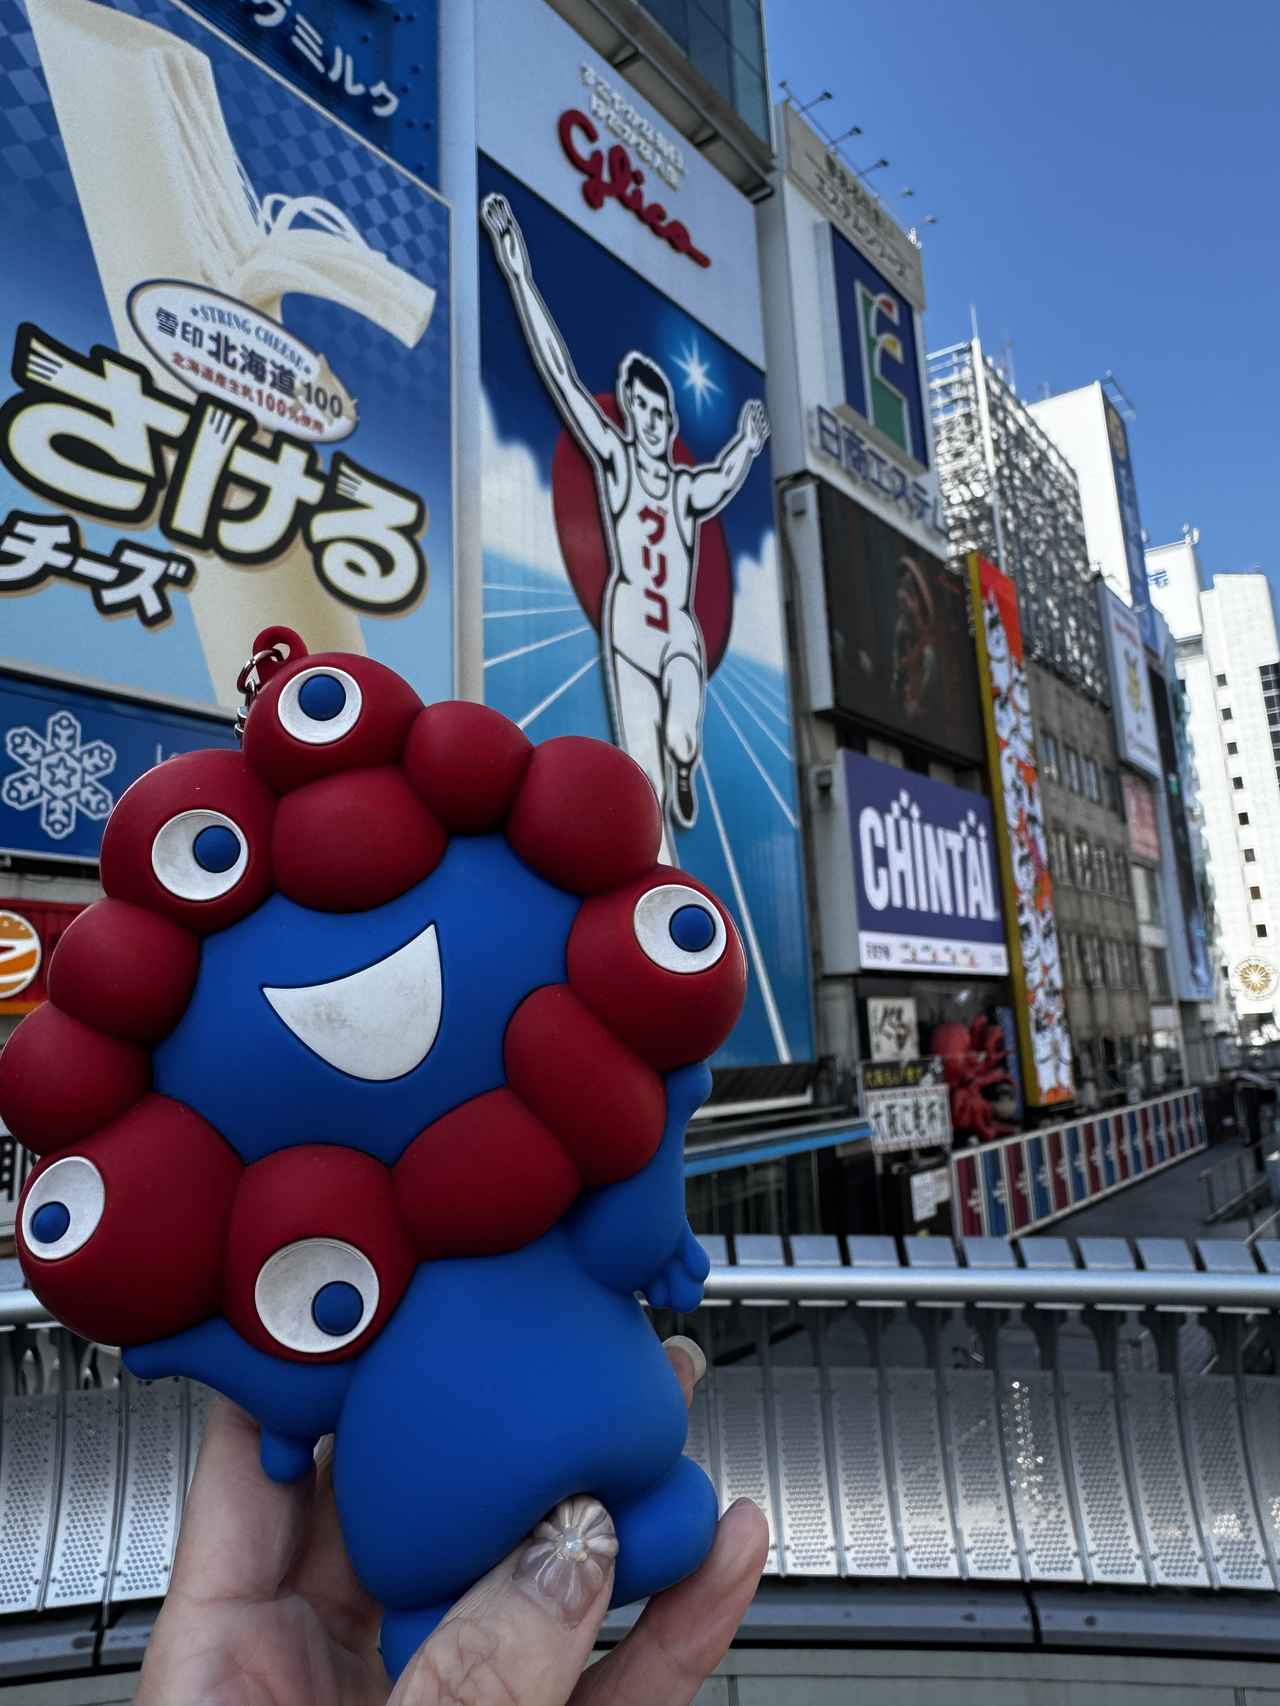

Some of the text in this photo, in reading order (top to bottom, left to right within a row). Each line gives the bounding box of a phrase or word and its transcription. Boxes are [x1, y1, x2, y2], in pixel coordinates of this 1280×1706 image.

[558, 109, 711, 269] Glico
[199, 304, 304, 370] STRING CHEESE
[6, 334, 420, 604] さける
[0, 519, 187, 620] チーズ
[859, 790, 998, 922] CHINTAI
